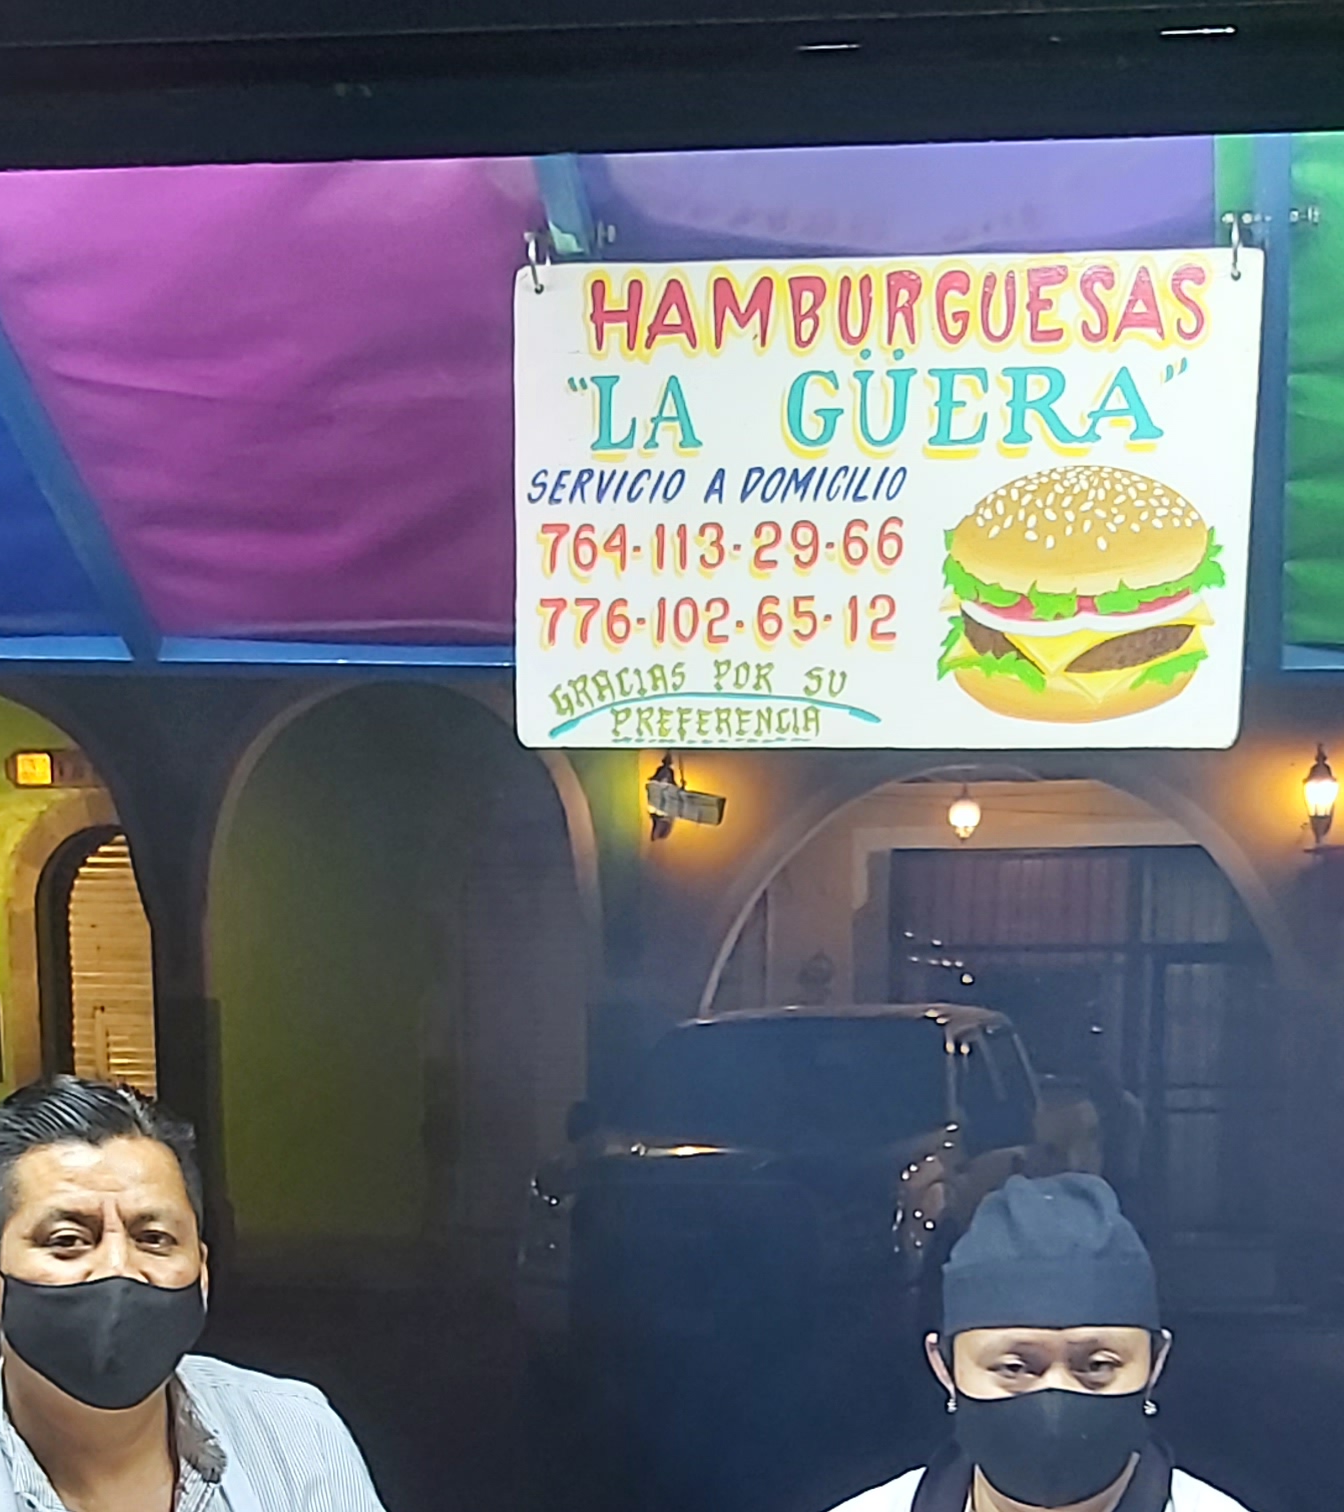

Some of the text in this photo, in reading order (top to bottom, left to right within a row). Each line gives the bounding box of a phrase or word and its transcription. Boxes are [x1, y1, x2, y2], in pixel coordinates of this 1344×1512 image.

[588, 262, 1209, 353] HAMBURGUESAS
[527, 465, 908, 505] SERVICIO A DOMICILIO
[547, 658, 849, 718] GRACIAS POR SU
[610, 705, 821, 741] PREFERENCIA
